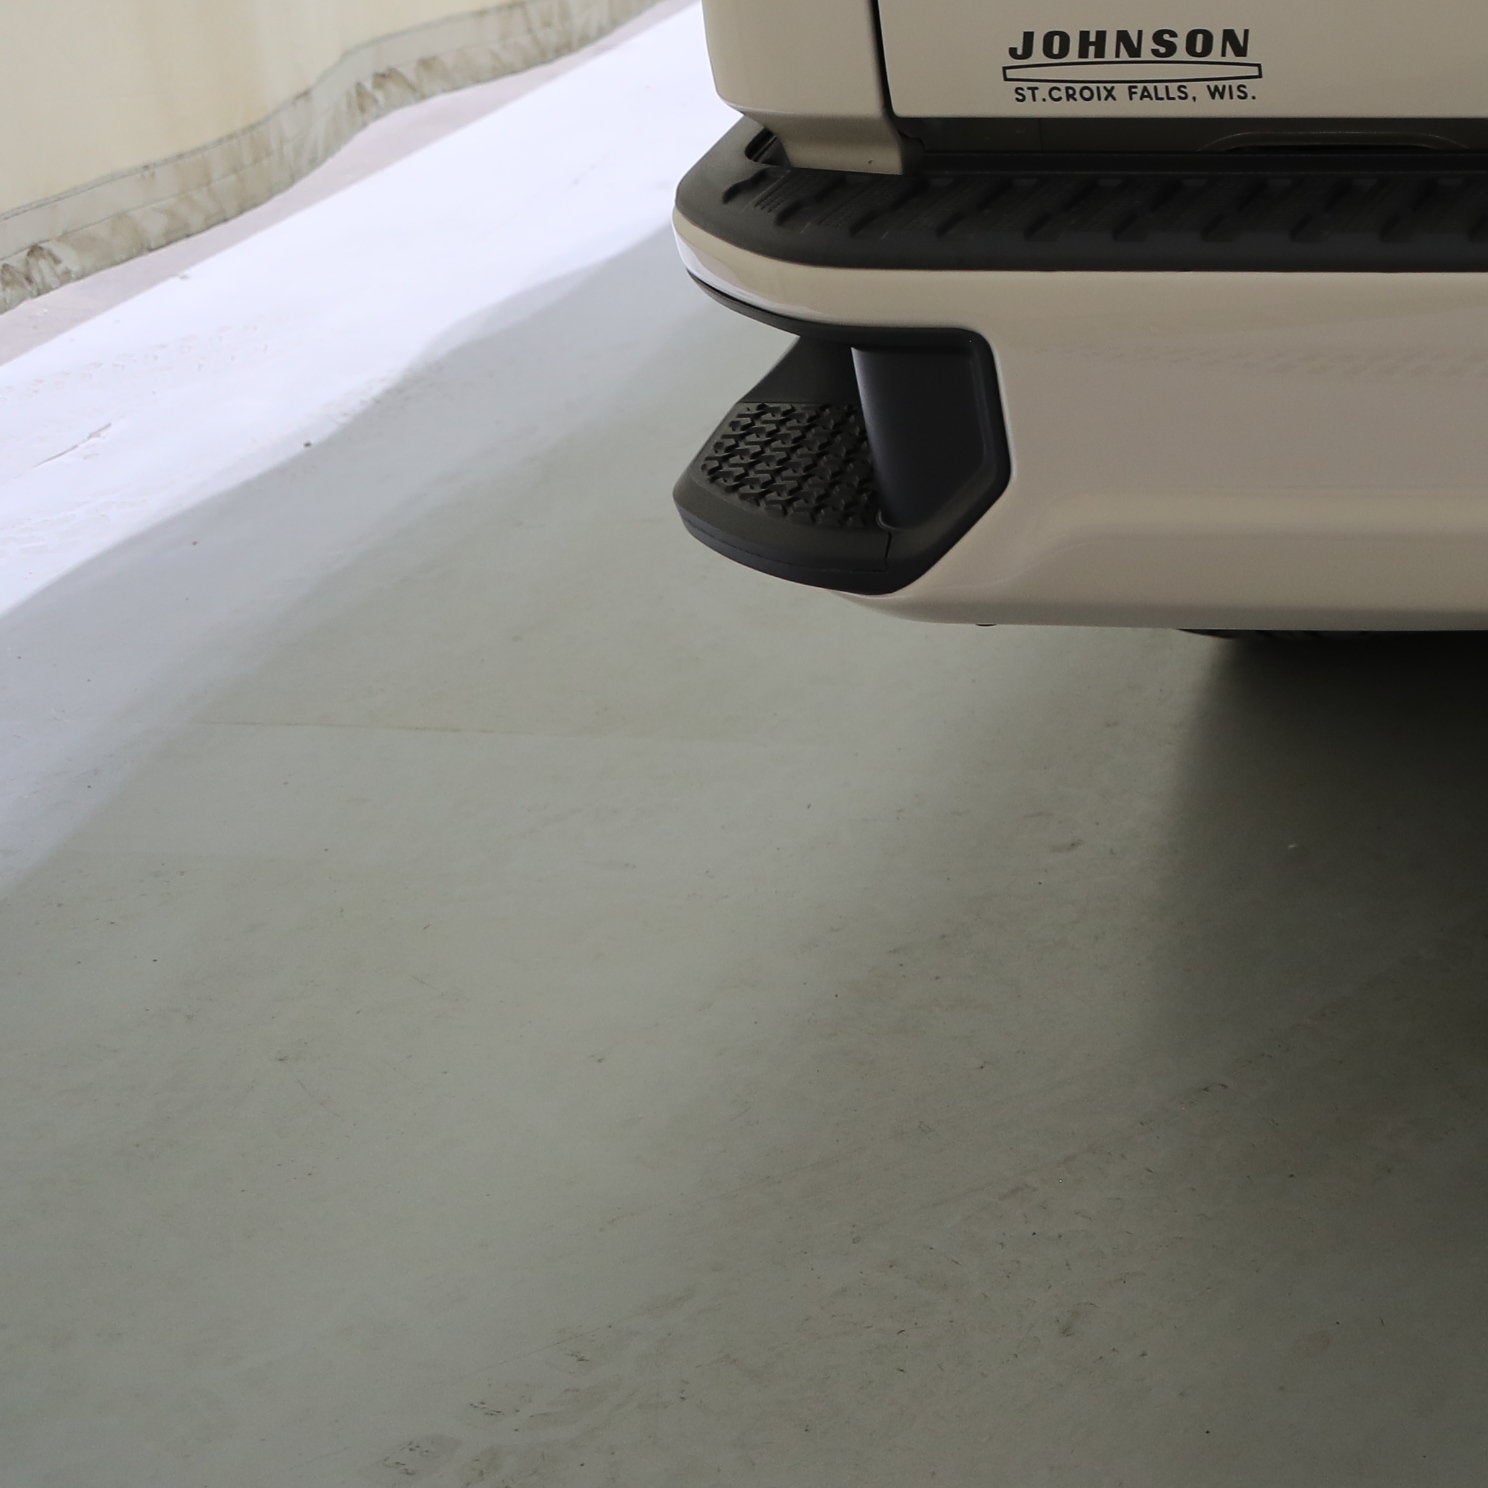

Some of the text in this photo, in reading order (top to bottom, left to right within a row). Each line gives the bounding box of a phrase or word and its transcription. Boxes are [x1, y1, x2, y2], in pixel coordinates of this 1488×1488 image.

[1008, 28, 1250, 60] JOHNSON
[1128, 84, 1197, 102] FALLS,
[1206, 83, 1257, 101] WIS.
